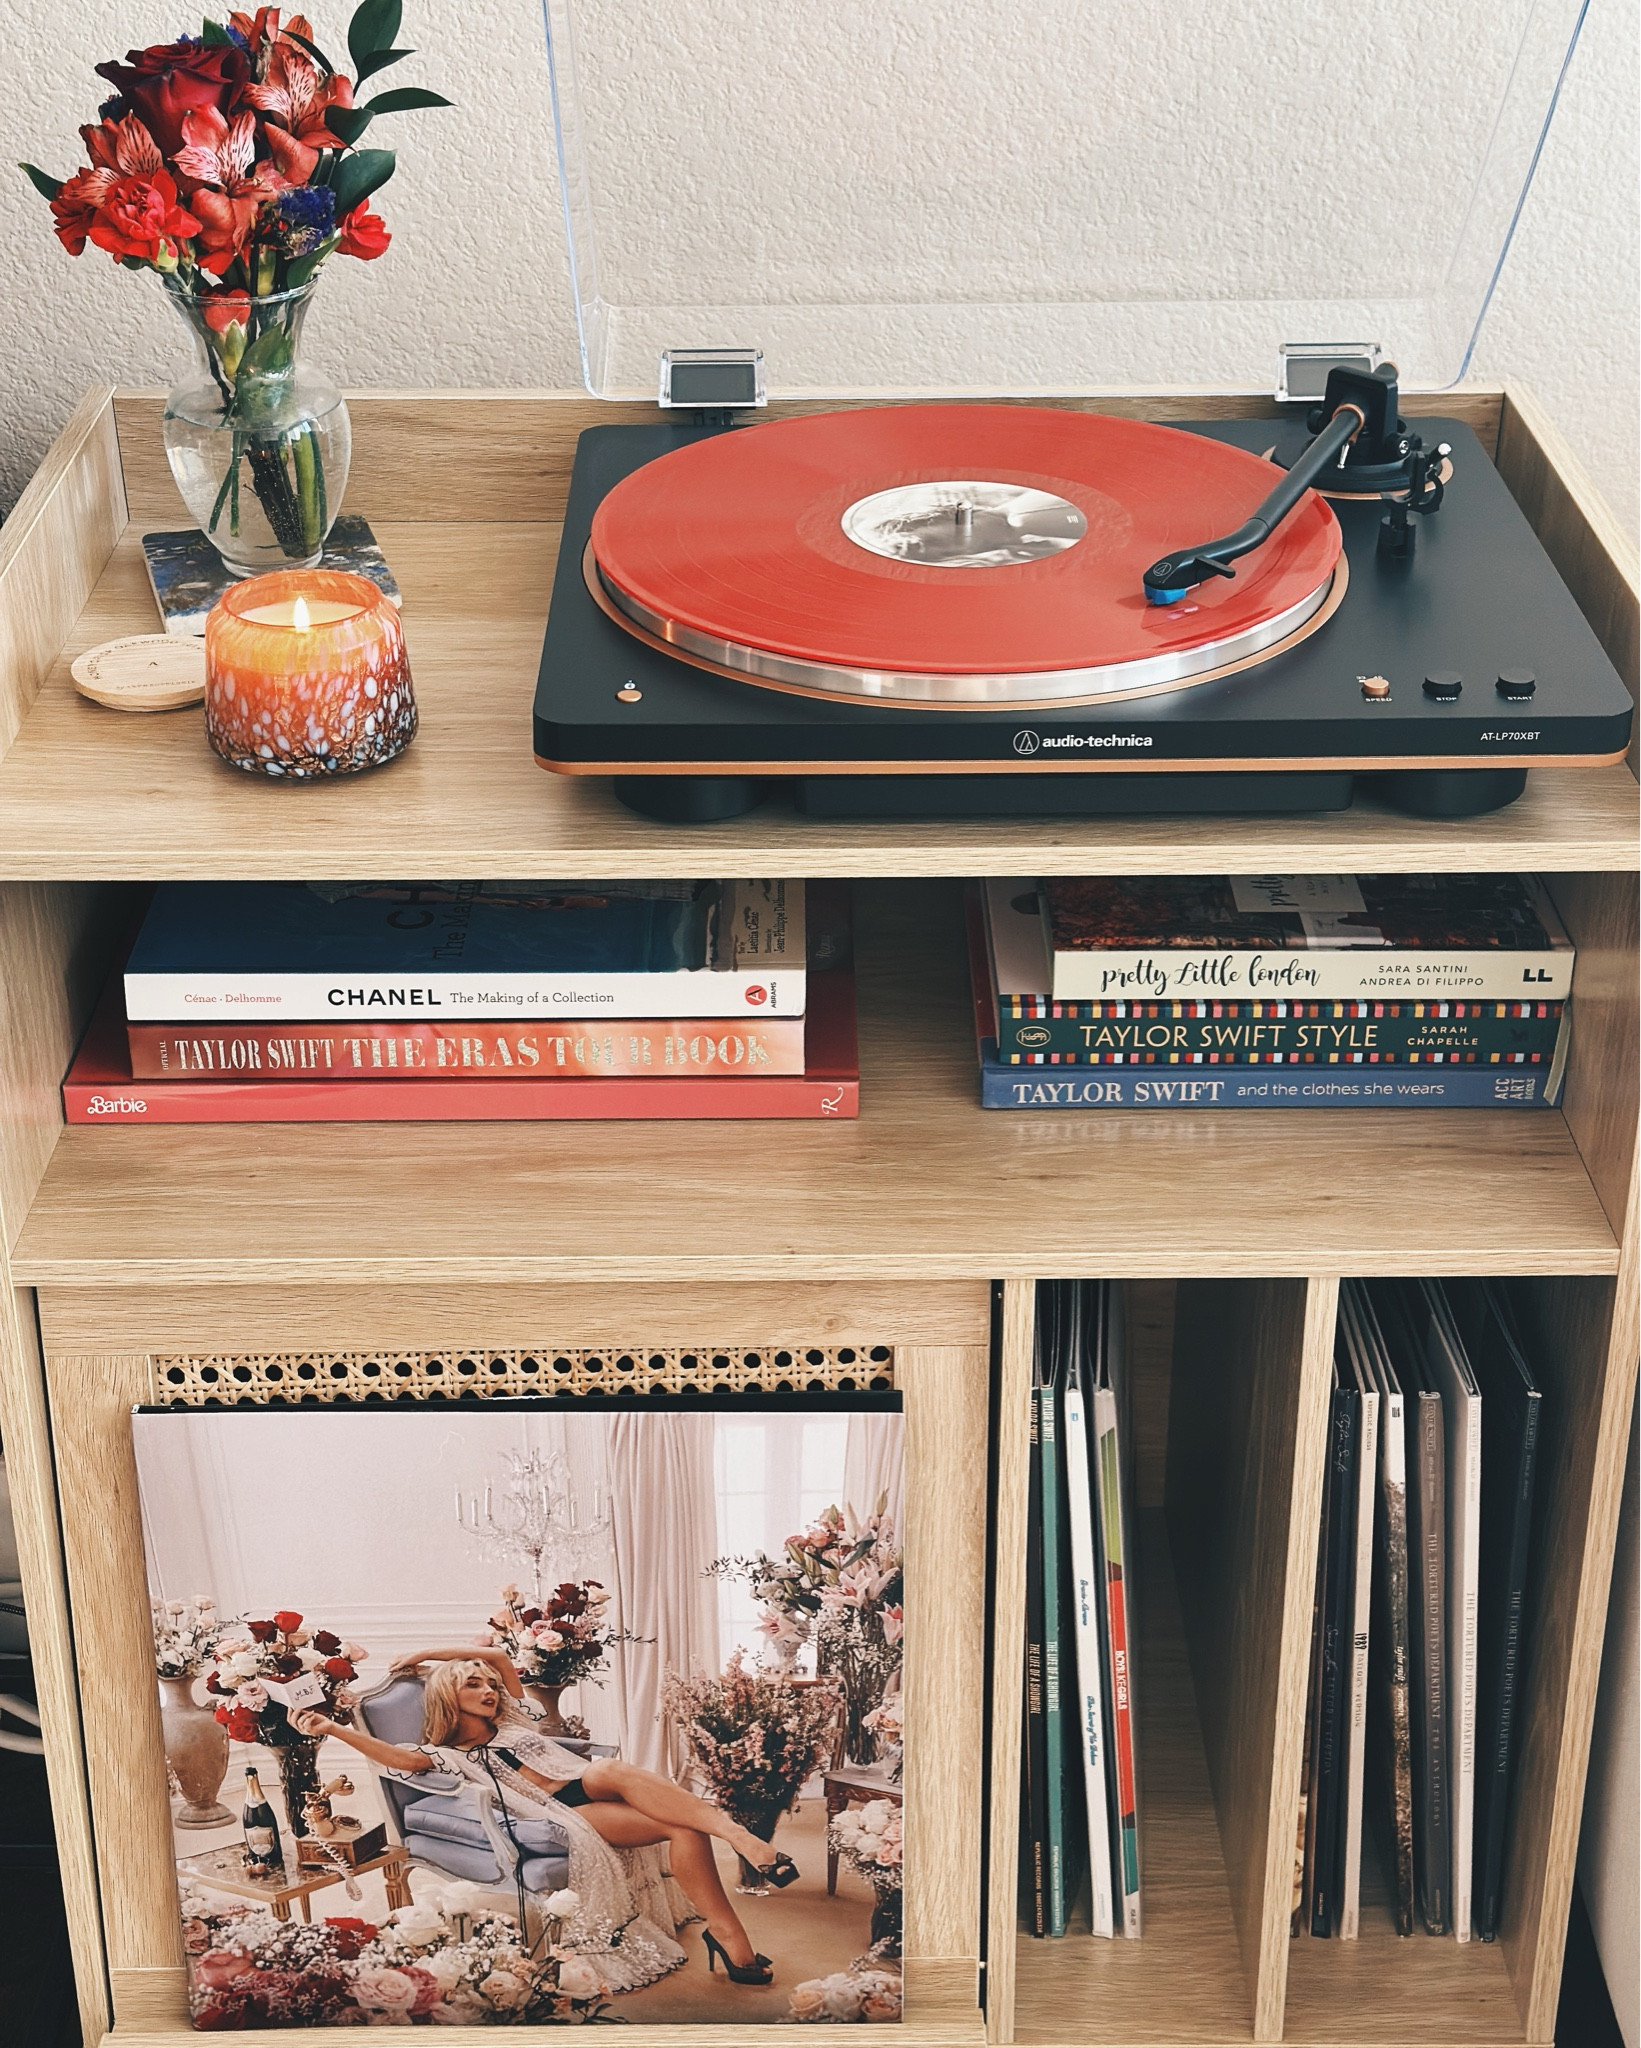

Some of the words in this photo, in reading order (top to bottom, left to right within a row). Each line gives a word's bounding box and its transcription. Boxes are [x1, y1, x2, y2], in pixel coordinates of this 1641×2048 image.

[1042, 733, 1153, 748] audio-technica
[1480, 731, 1541, 741] AT-LP70XBT
[1100, 958, 1171, 996] pretty
[1173, 954, 1242, 987] Little
[1248, 954, 1321, 987] london
[1378, 965, 1411, 973] SARA
[1416, 965, 1469, 973] SANTINI
[1359, 977, 1412, 986] ANDREA
[1416, 977, 1430, 986] DI
[1435, 977, 1485, 986] FILIPPO
[184, 993, 217, 1003] Cénac
[225, 993, 282, 1003] Delhomme
[327, 988, 442, 1006] CHANEL
[450, 991, 474, 1003] The
[477, 991, 524, 1006] Making
[527, 991, 540, 1003] of
[541, 994, 549, 1003] a
[552, 991, 615, 1003] Collection
[1079, 1025, 1189, 1048] TAYLOR
[1199, 1025, 1287, 1048] SWIFT
[1295, 1025, 1379, 1048] STYLE
[1421, 1026, 1468, 1034] SARAH
[174, 1038, 262, 1071] TAYLOR
[267, 1038, 335, 1070] SWIFT
[343, 1037, 427, 1069] THE
[436, 1036, 541, 1068] ERAS
[547, 1035, 652, 1067] TOUR
[664, 1034, 773, 1066] BOOK
[1407, 1037, 1479, 1046] CHAPELLE
[1012, 1082, 1124, 1104] TAYLOR
[1134, 1081, 1225, 1103] SWIFT
[1237, 1083, 1268, 1096] and
[1272, 1083, 1299, 1096] the
[1302, 1082, 1360, 1096] clothes
[1363, 1082, 1393, 1095] she
[1397, 1084, 1446, 1095] wears
[1494, 1078, 1510, 1100] ACC
[1509, 1078, 1525, 1100] ART
[86, 1095, 148, 1115] Barbie
[821, 1086, 844, 1115] R
[1042, 1396, 1054, 1421] TAYLOR
[1043, 1421, 1055, 1443] SWIFT
[1427, 1533, 1438, 1554] THE
[1428, 1557, 1439, 1614] TORTURED
[1466, 1591, 1476, 1612] THE
[1511, 1589, 1522, 1610] THE
[1354, 1632, 1368, 1650] 1989
[1429, 1617, 1440, 1649] POETS
[1464, 1615, 1475, 1671] TORTURED
[1505, 1614, 1520, 1670] TORTURED
[1029, 1643, 1040, 1655] THE
[1046, 1641, 1058, 1652] THE
[1393, 1646, 1406, 1664] taylor
[1029, 1655, 1041, 1668] LIFE
[1046, 1653, 1059, 1665] LIFE
[1029, 1668, 1041, 1676] OF
[1047, 1666, 1059, 1675] OF
[1047, 1681, 1060, 1713] SHOWGIRL
[1430, 1652, 1441, 1720] DEPARTMENT
[1463, 1674, 1474, 1706] POETS
[1502, 1673, 1515, 1705] POETS
[1029, 1683, 1042, 1715] SHOWGIRL
[1354, 1694, 1362, 1727] VERSION
[1462, 1708, 1474, 1775] DEPARTMENT
[1497, 1707, 1511, 1775] DEPARTMENT
[1433, 1758, 1441, 1827] ANTHOLOGY
